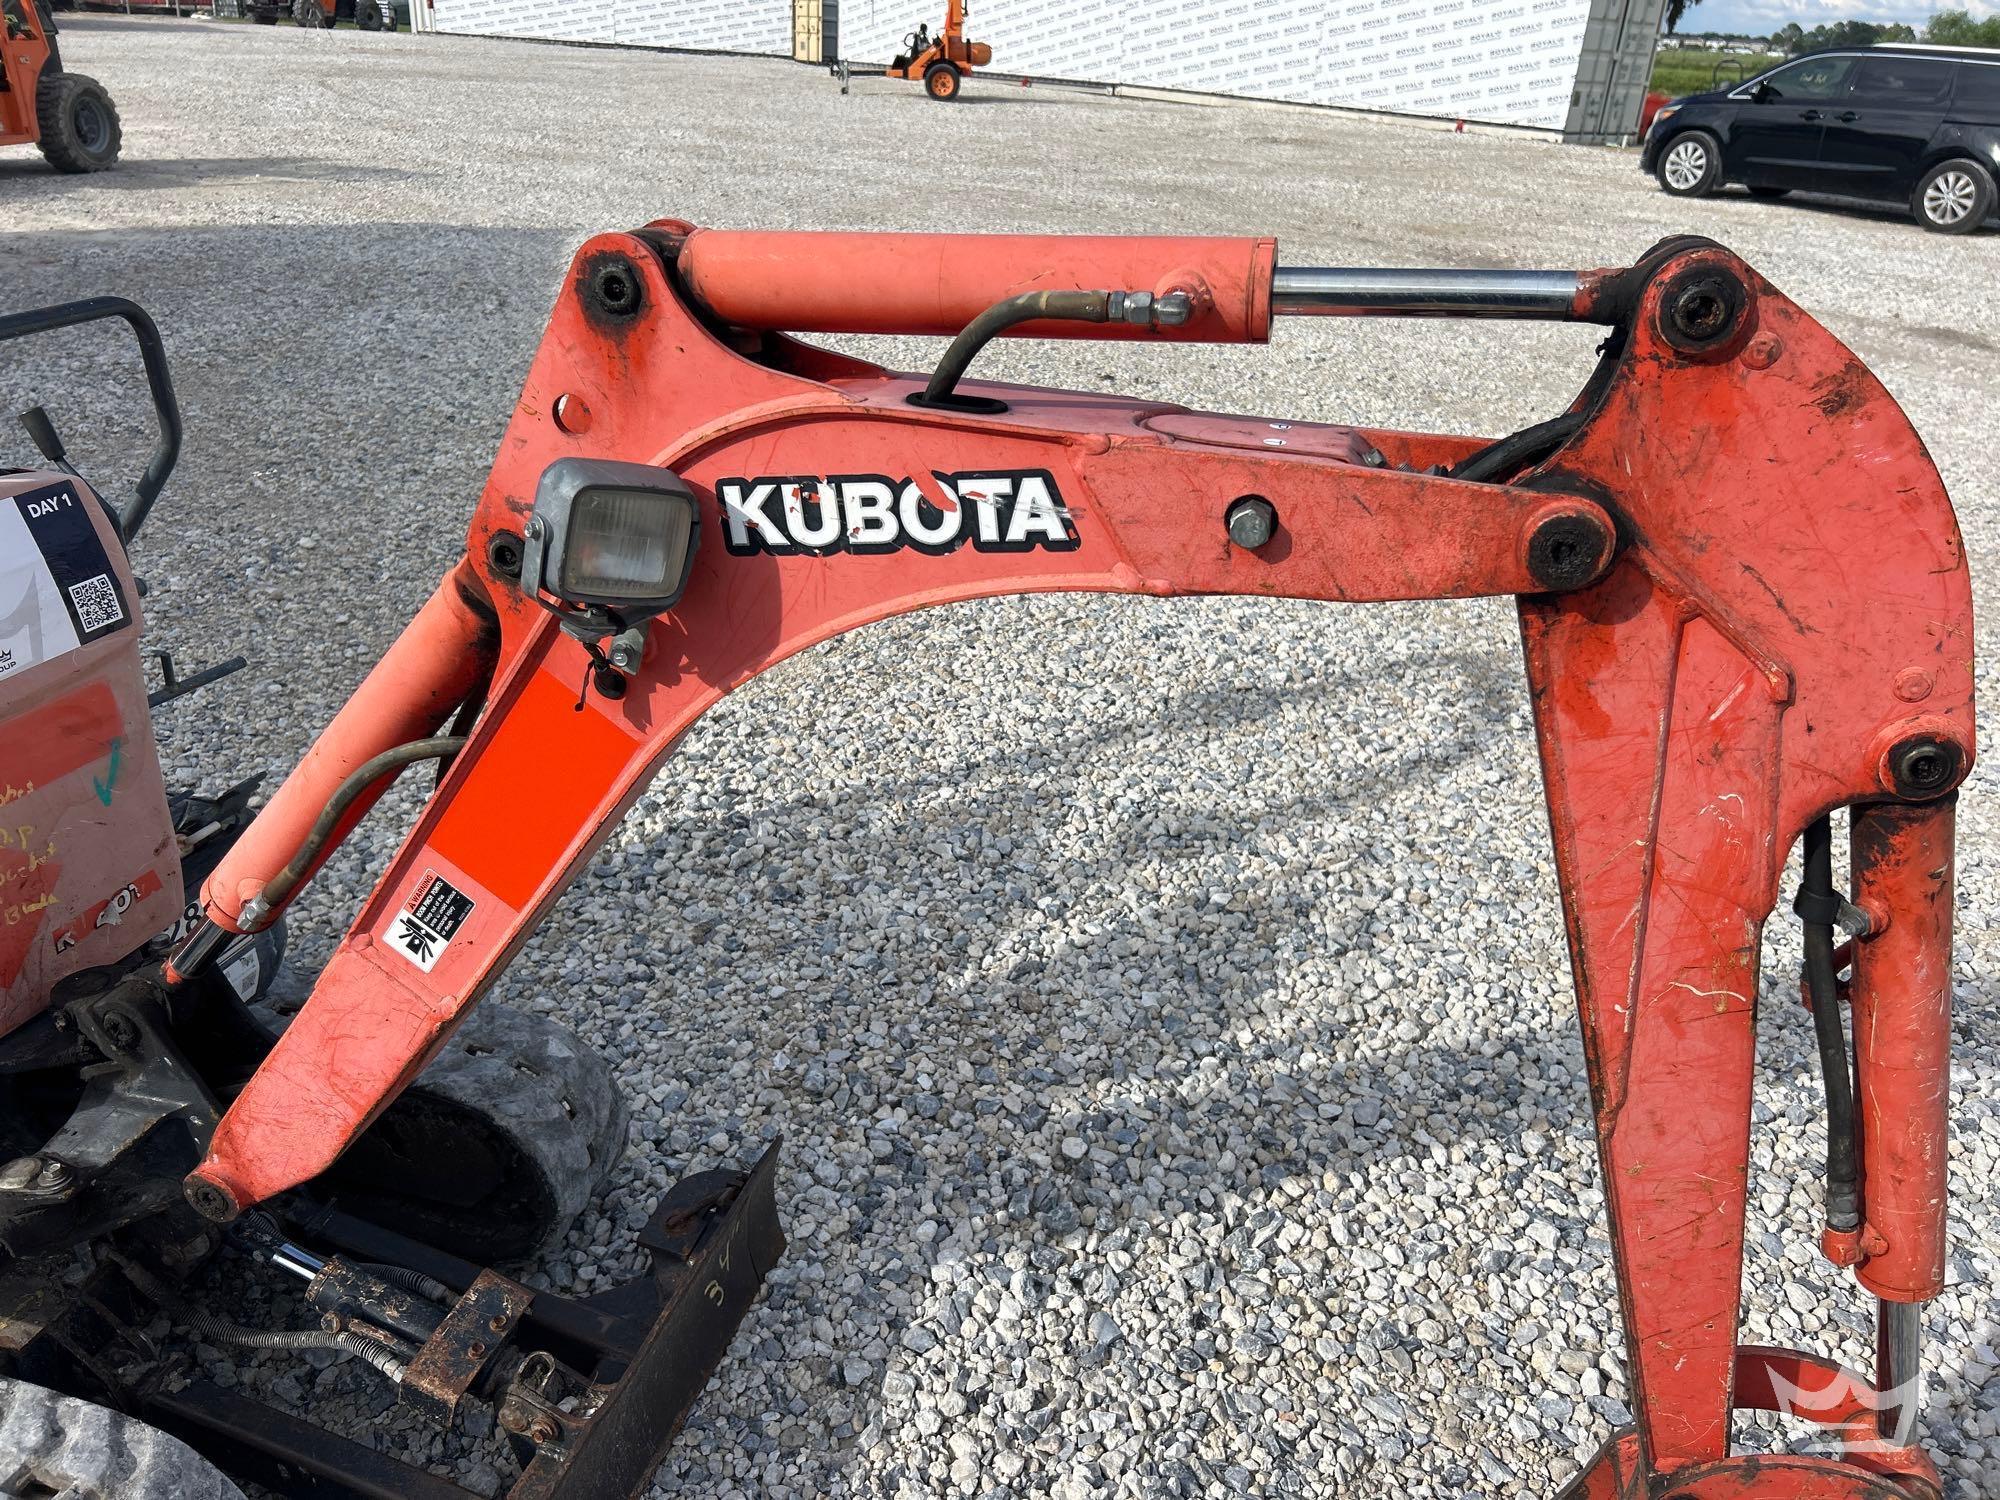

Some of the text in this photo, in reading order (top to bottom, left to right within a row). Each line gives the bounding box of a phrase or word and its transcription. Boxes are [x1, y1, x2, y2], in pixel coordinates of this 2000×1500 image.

[27, 493, 72, 518] DAY 1
[720, 475, 1072, 549] KUBOTA
[411, 874, 433, 903] WARNING
